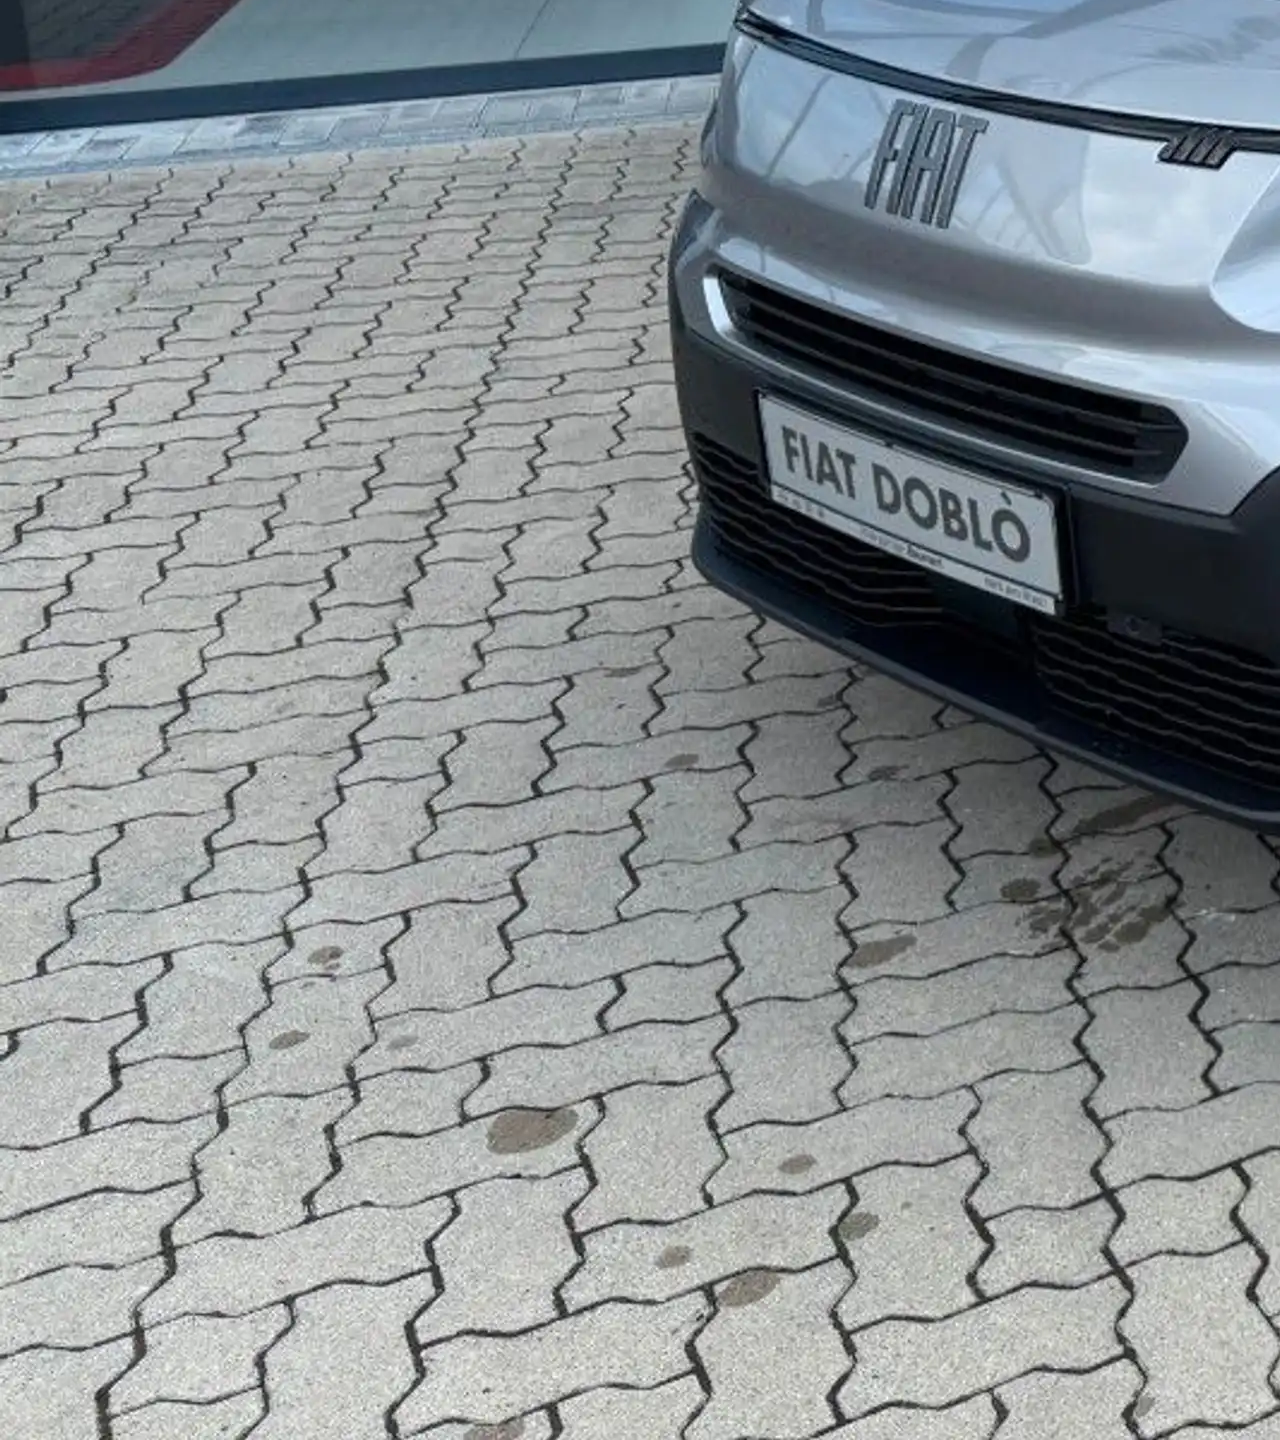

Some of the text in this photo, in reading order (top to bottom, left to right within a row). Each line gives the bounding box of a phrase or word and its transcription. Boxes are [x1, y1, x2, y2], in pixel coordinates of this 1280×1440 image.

[863, 98, 989, 229] FIAT
[781, 425, 857, 500] FIAT
[872, 463, 1031, 563] DOBLÒ
